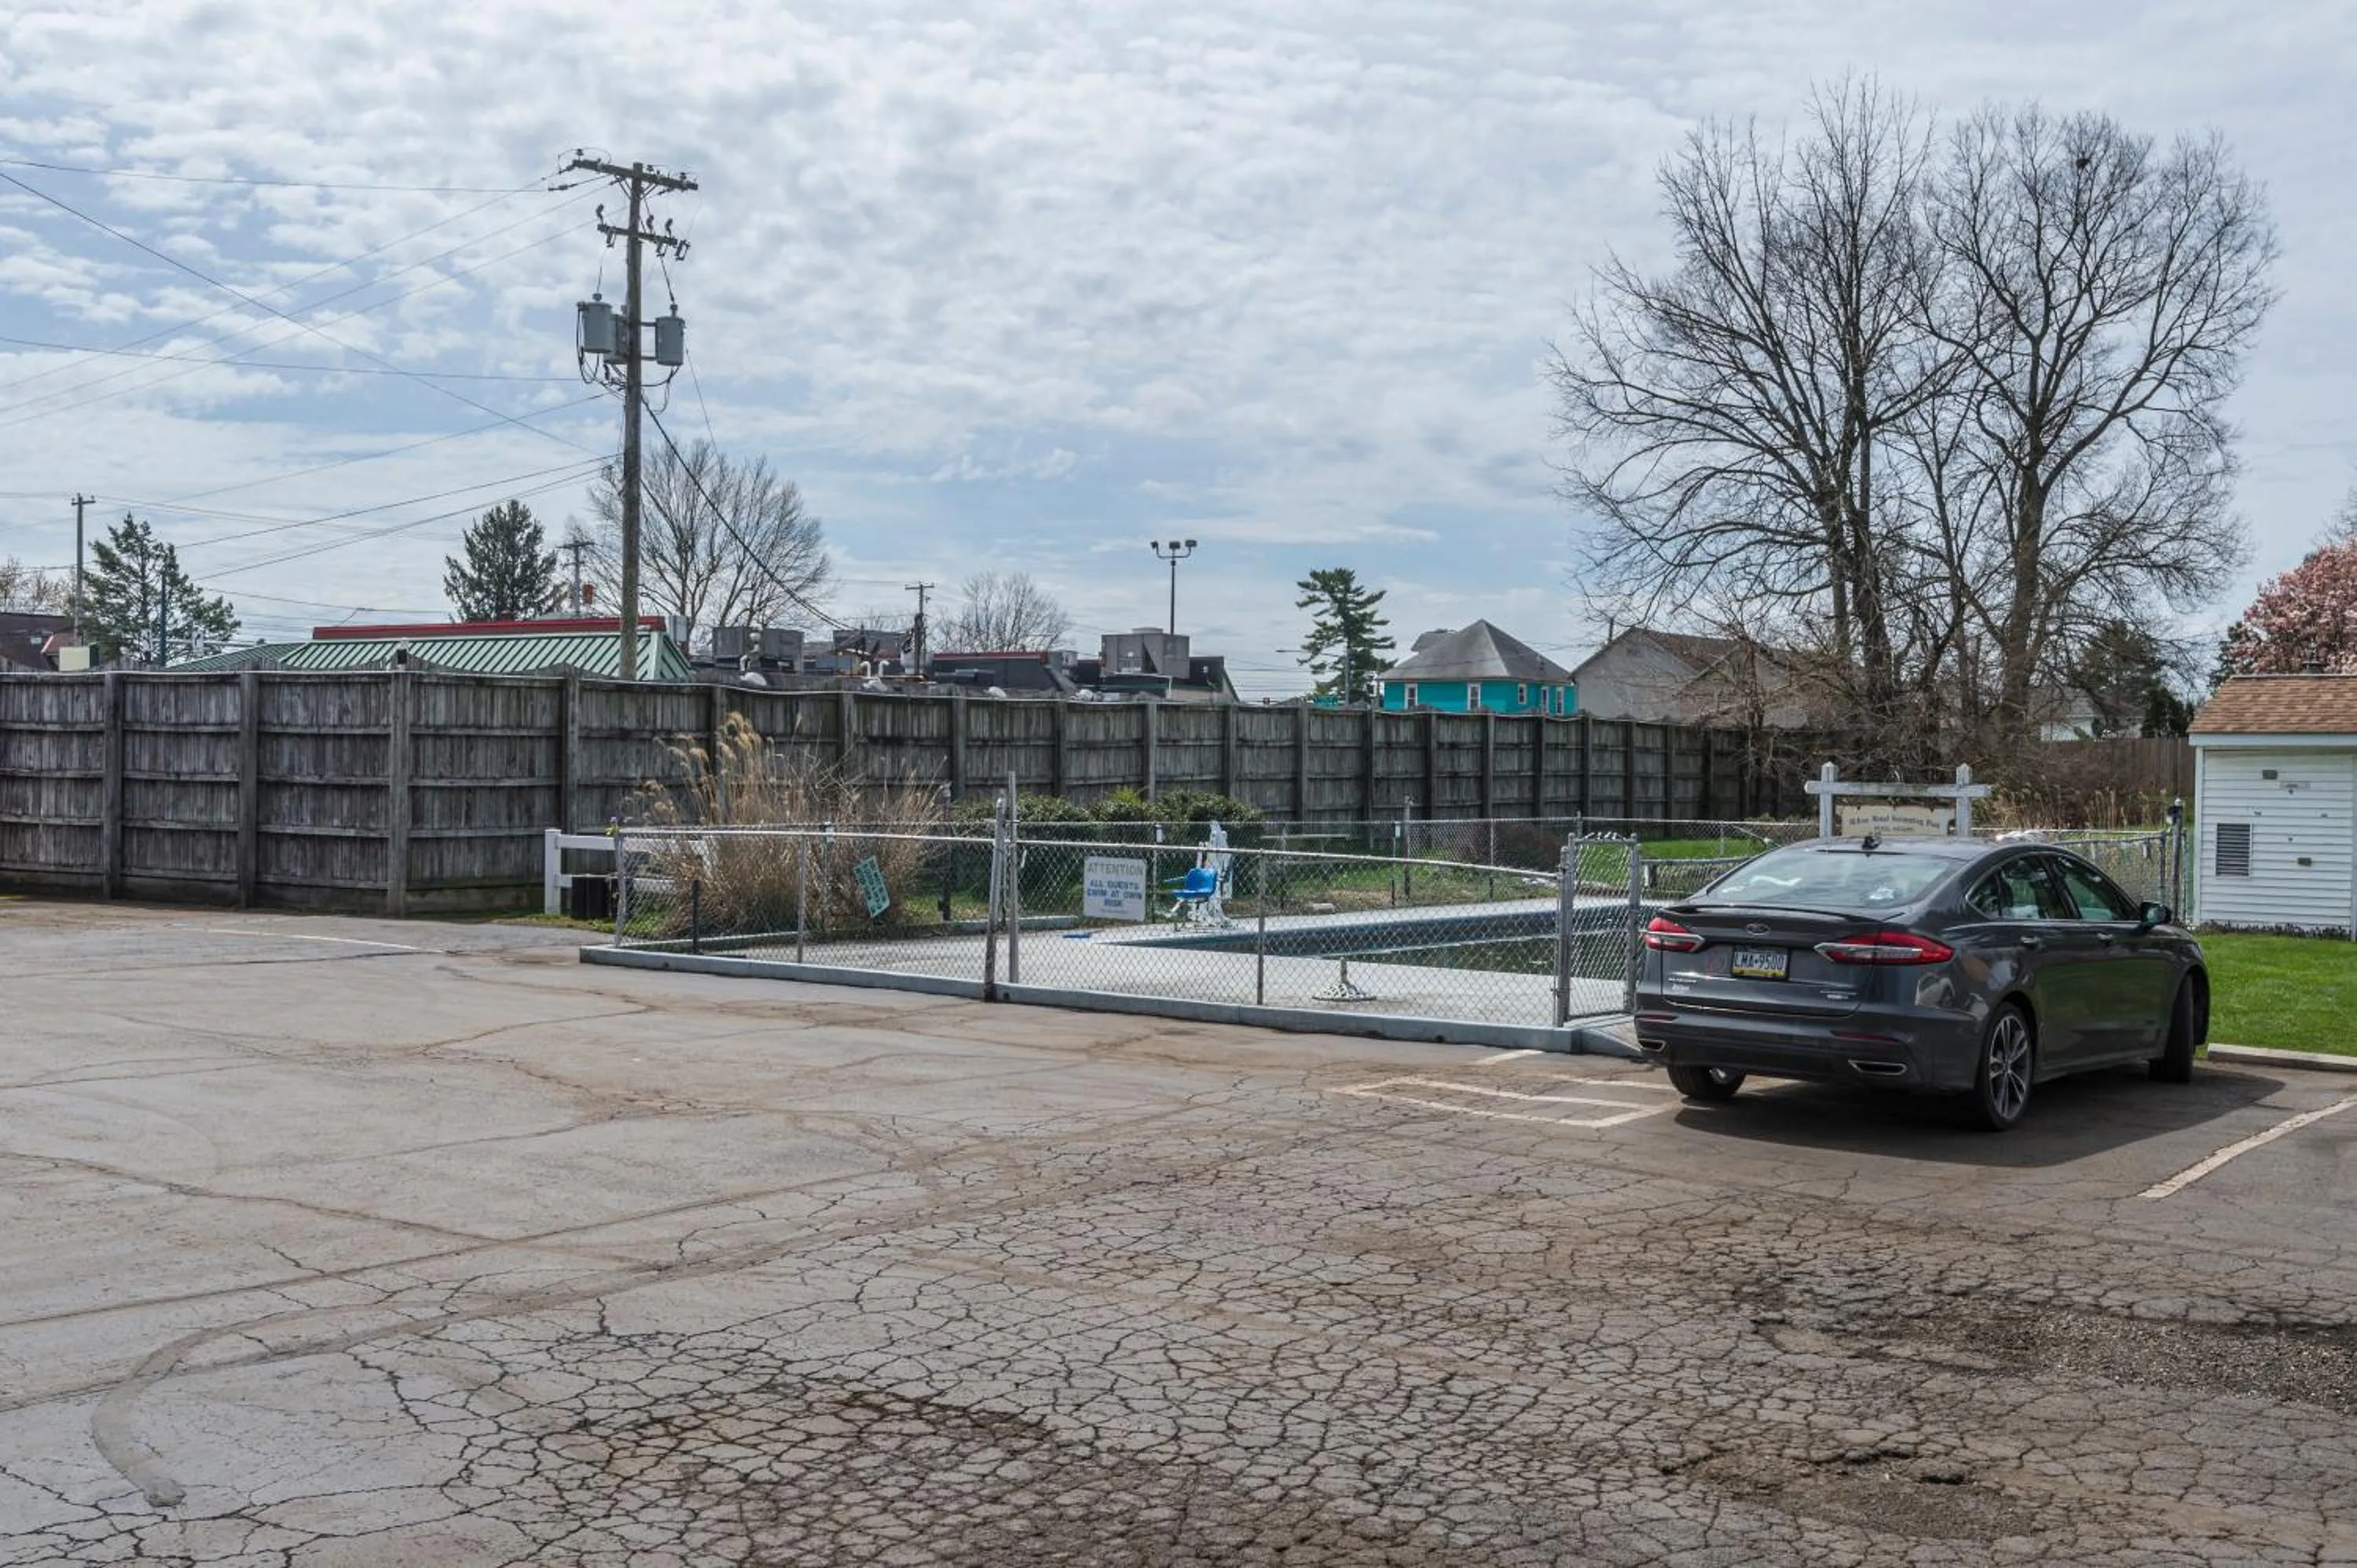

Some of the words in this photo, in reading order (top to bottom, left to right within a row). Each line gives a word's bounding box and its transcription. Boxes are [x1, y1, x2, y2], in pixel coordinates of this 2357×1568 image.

[1087, 863, 1143, 876] ATTENTION
[1107, 881, 1139, 890] GUESTS
[1124, 891, 1142, 899] OWN
